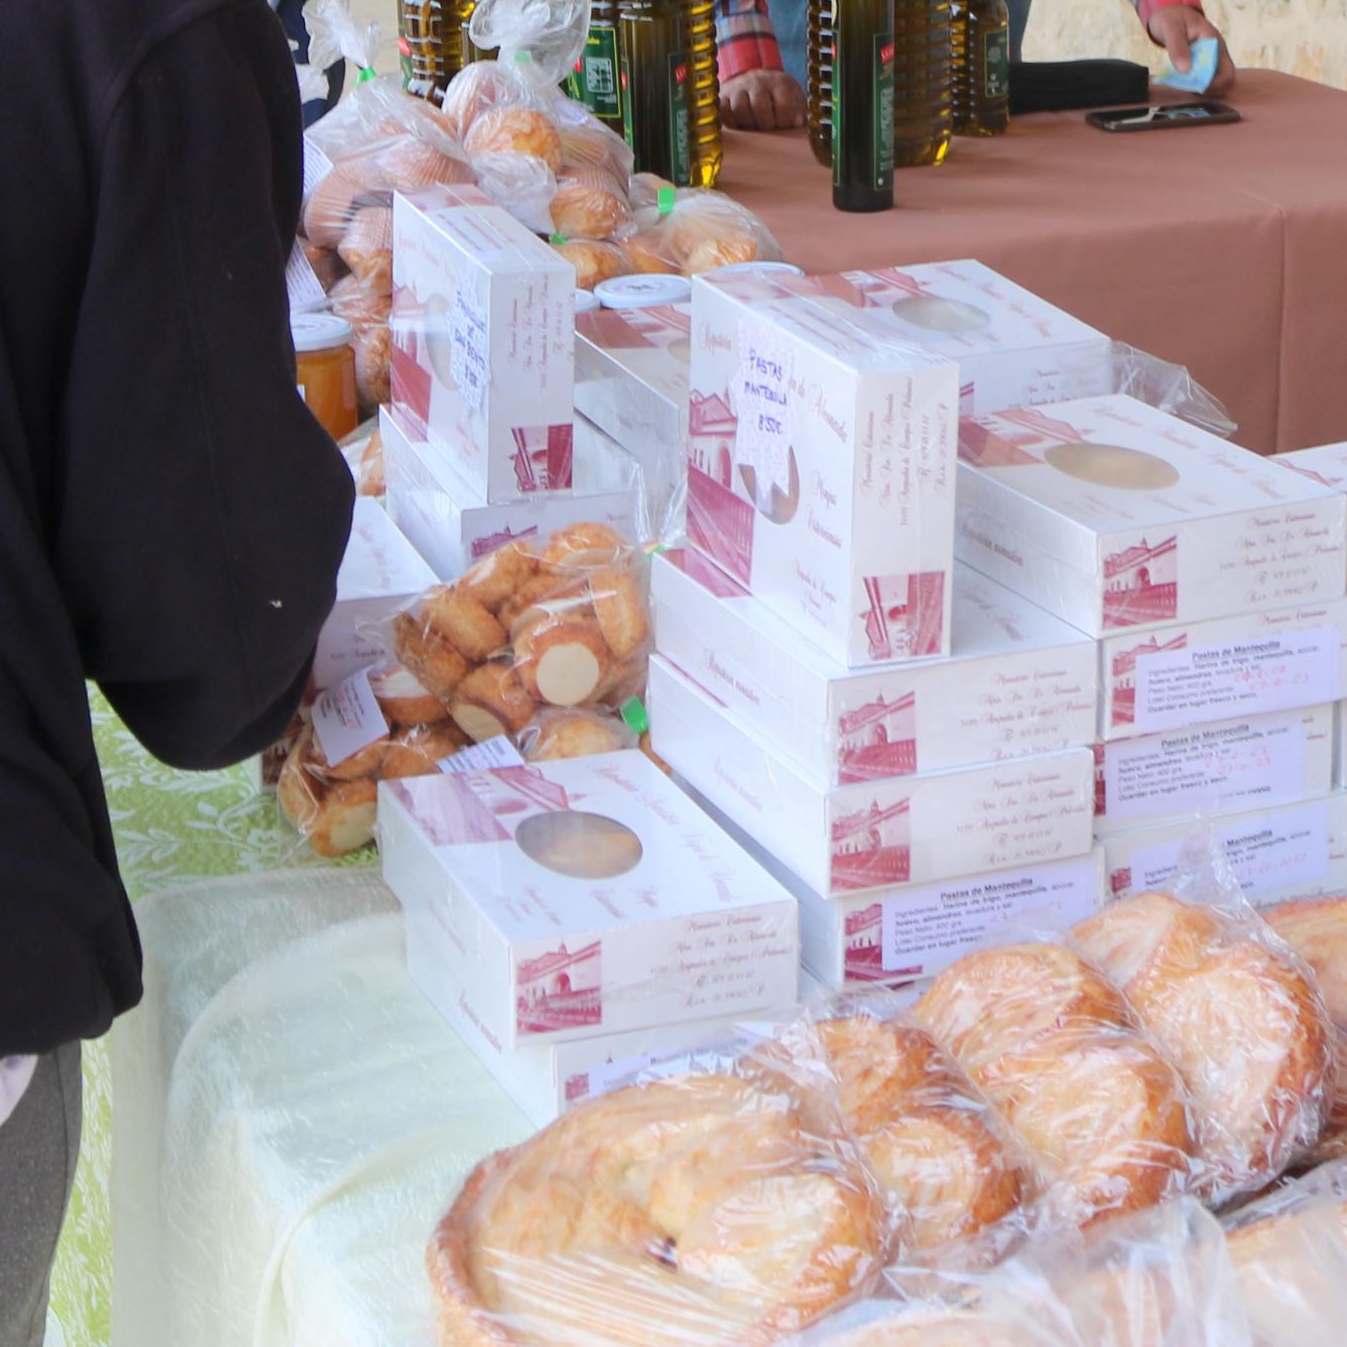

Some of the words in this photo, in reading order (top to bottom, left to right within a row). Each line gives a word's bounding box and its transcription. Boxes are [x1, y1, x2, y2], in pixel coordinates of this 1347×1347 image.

[749, 348, 783, 382] PASTAS
[941, 889, 969, 902] Pastas
[984, 878, 1033, 894] Mantequilla
